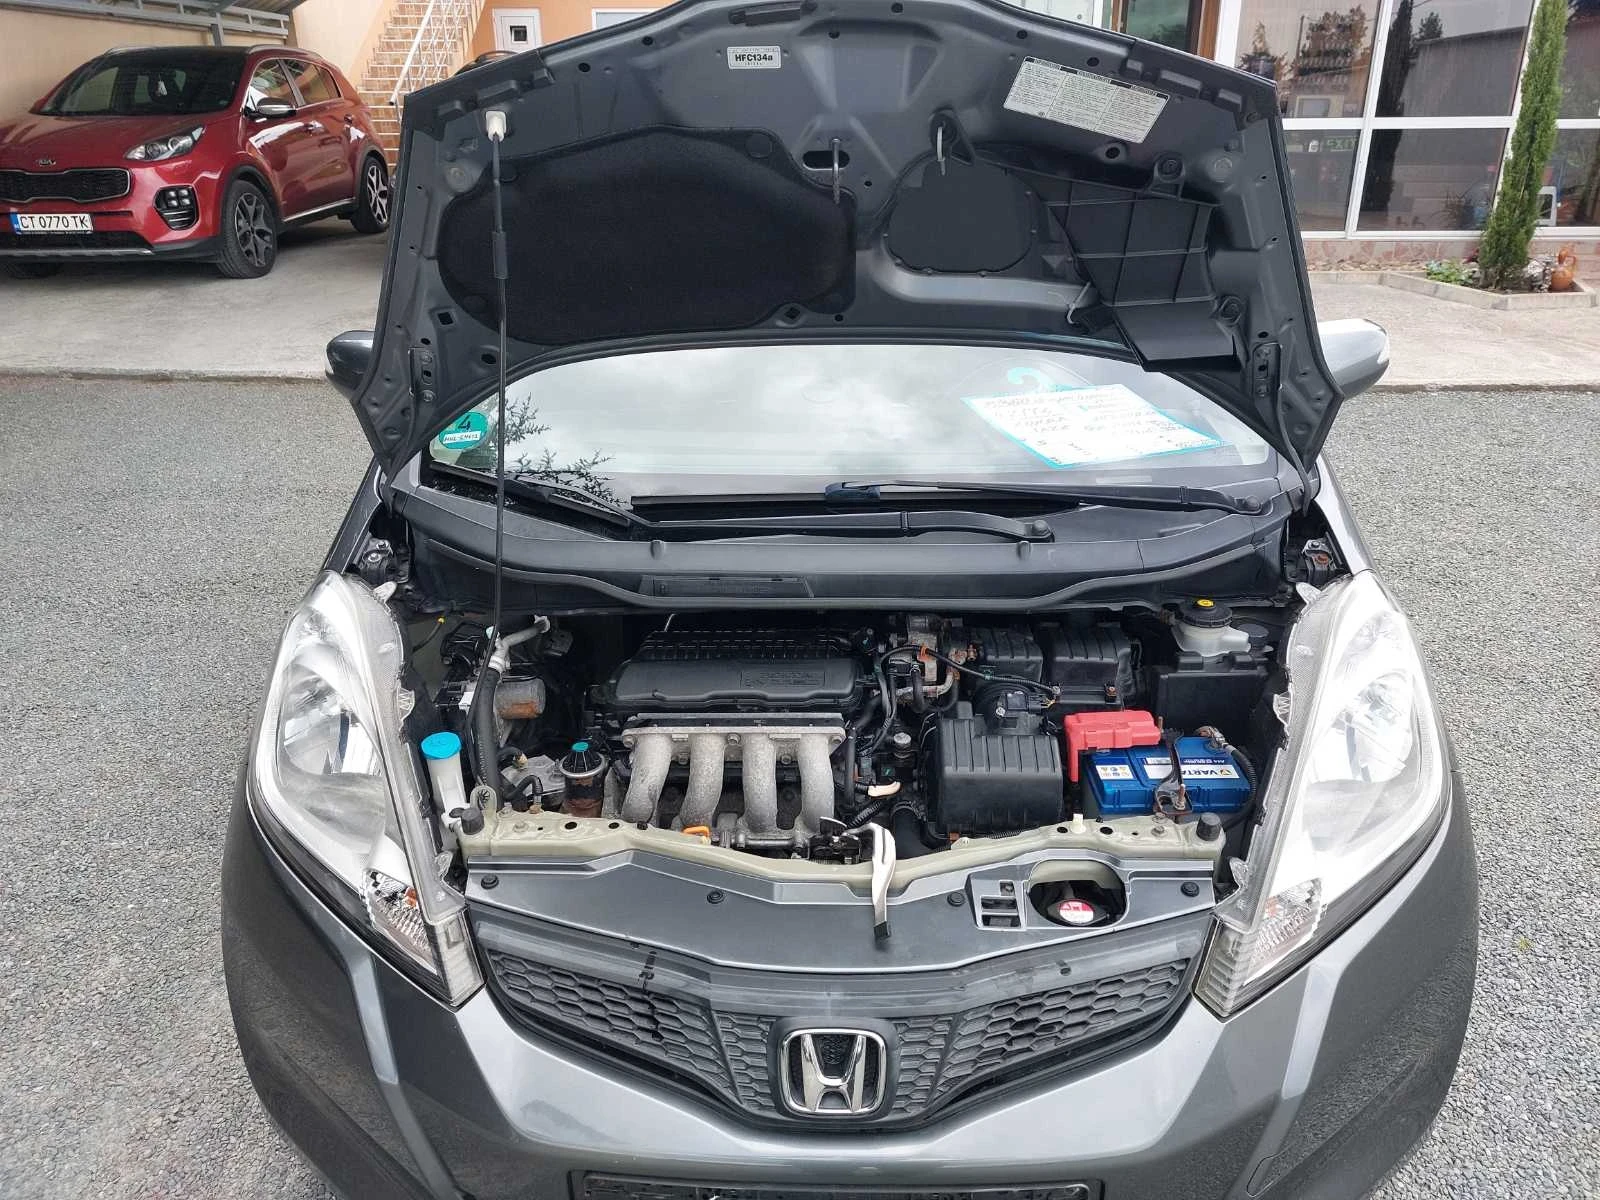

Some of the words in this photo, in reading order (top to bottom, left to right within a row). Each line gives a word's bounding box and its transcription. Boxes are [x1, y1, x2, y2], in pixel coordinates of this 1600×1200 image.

[735, 54, 773, 62] HFC134a
[20, 215, 35, 229] CT
[39, 215, 69, 229] 0770
[71, 215, 89, 229] TK
[457, 415, 471, 431] 4
